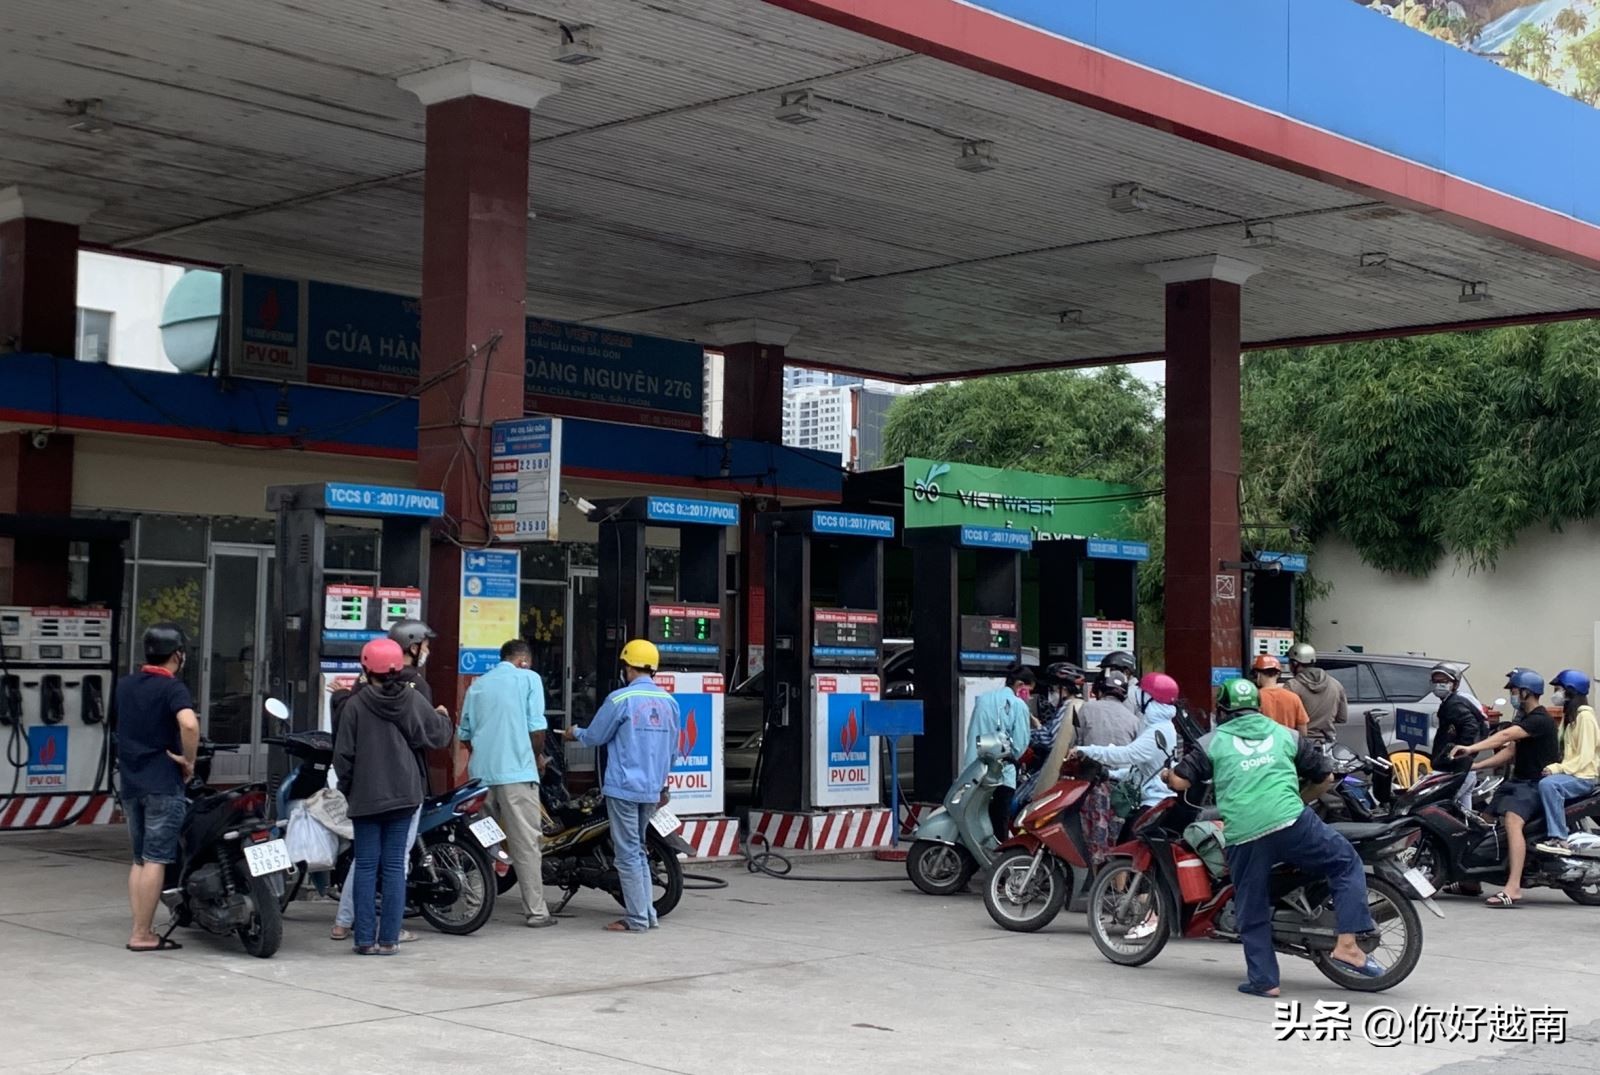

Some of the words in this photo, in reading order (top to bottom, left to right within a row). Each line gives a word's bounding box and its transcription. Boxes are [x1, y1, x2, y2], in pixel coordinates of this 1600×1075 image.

[325, 323, 373, 355] CỬA
[380, 334, 422, 361] HÀN
[526, 355, 578, 384] OÀNG
[584, 367, 659, 395] NGUYÊN
[664, 379, 693, 400] 276
[331, 488, 360, 503] TCCS
[652, 501, 676, 514] TCCS
[816, 515, 838, 527] TCCS
[964, 529, 983, 541] TCCS
[1240, 754, 1276, 772] gojek
[29, 776, 44, 785] PV
[46, 776, 62, 785] OIL
[667, 774, 683, 789] PV
[686, 773, 707, 789] OIL
[831, 769, 846, 783] PV
[848, 769, 866, 782] OIL
